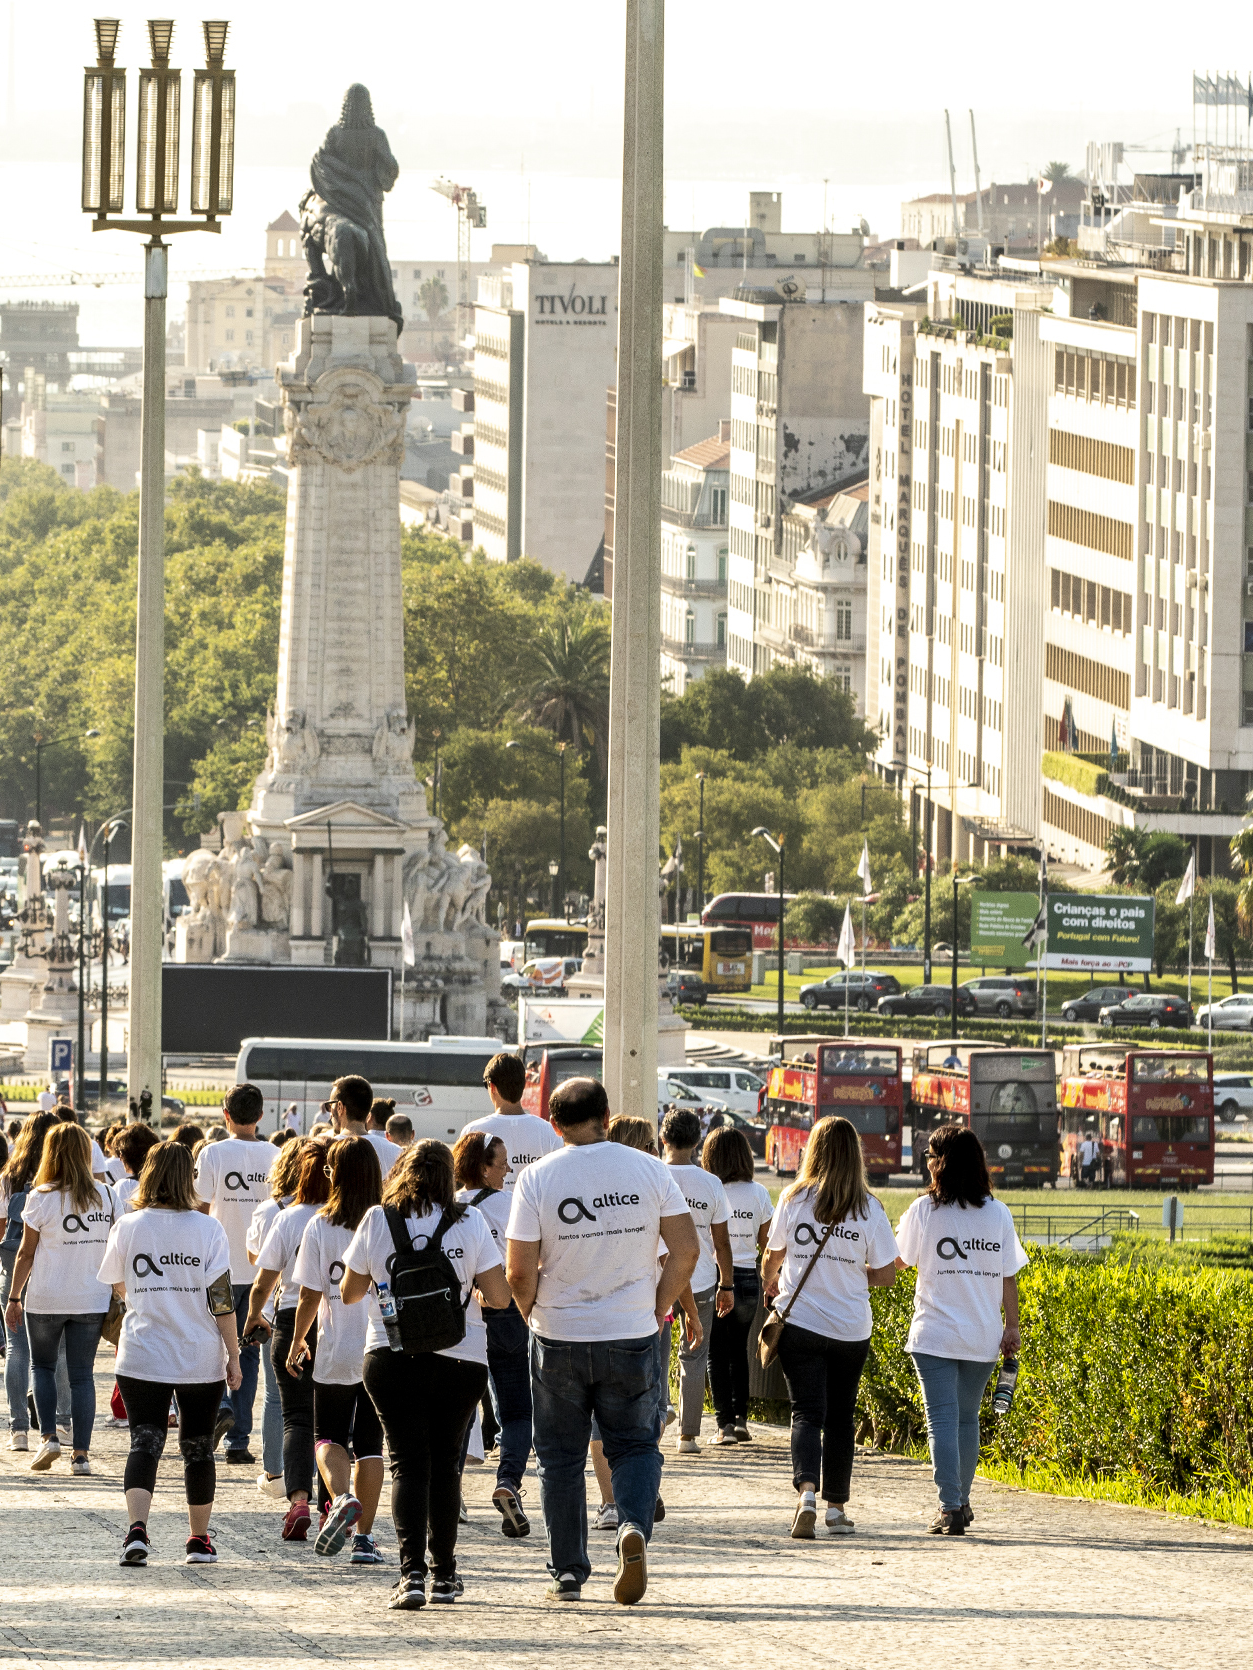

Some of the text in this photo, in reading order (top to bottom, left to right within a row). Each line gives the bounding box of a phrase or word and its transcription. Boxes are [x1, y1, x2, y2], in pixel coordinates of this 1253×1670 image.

[535, 283, 607, 315] TIVOLI
[900, 373, 911, 455] HOTEL
[897, 608, 907, 638] DE
[895, 656, 906, 754] POMBAL
[1054, 902, 1145, 919] Crianças e pais
[1062, 917, 1135, 929] com direitos
[1057, 931, 1091, 942] Portugal
[1112, 934, 1140, 943] Futuro!
[1081, 959, 1100, 967] força
[55, 1044, 68, 1067] P
[593, 1192, 639, 1208] altice
[87, 1211, 111, 1222] altic
[962, 1238, 1001, 1252] altice
[159, 1252, 201, 1267] altice
